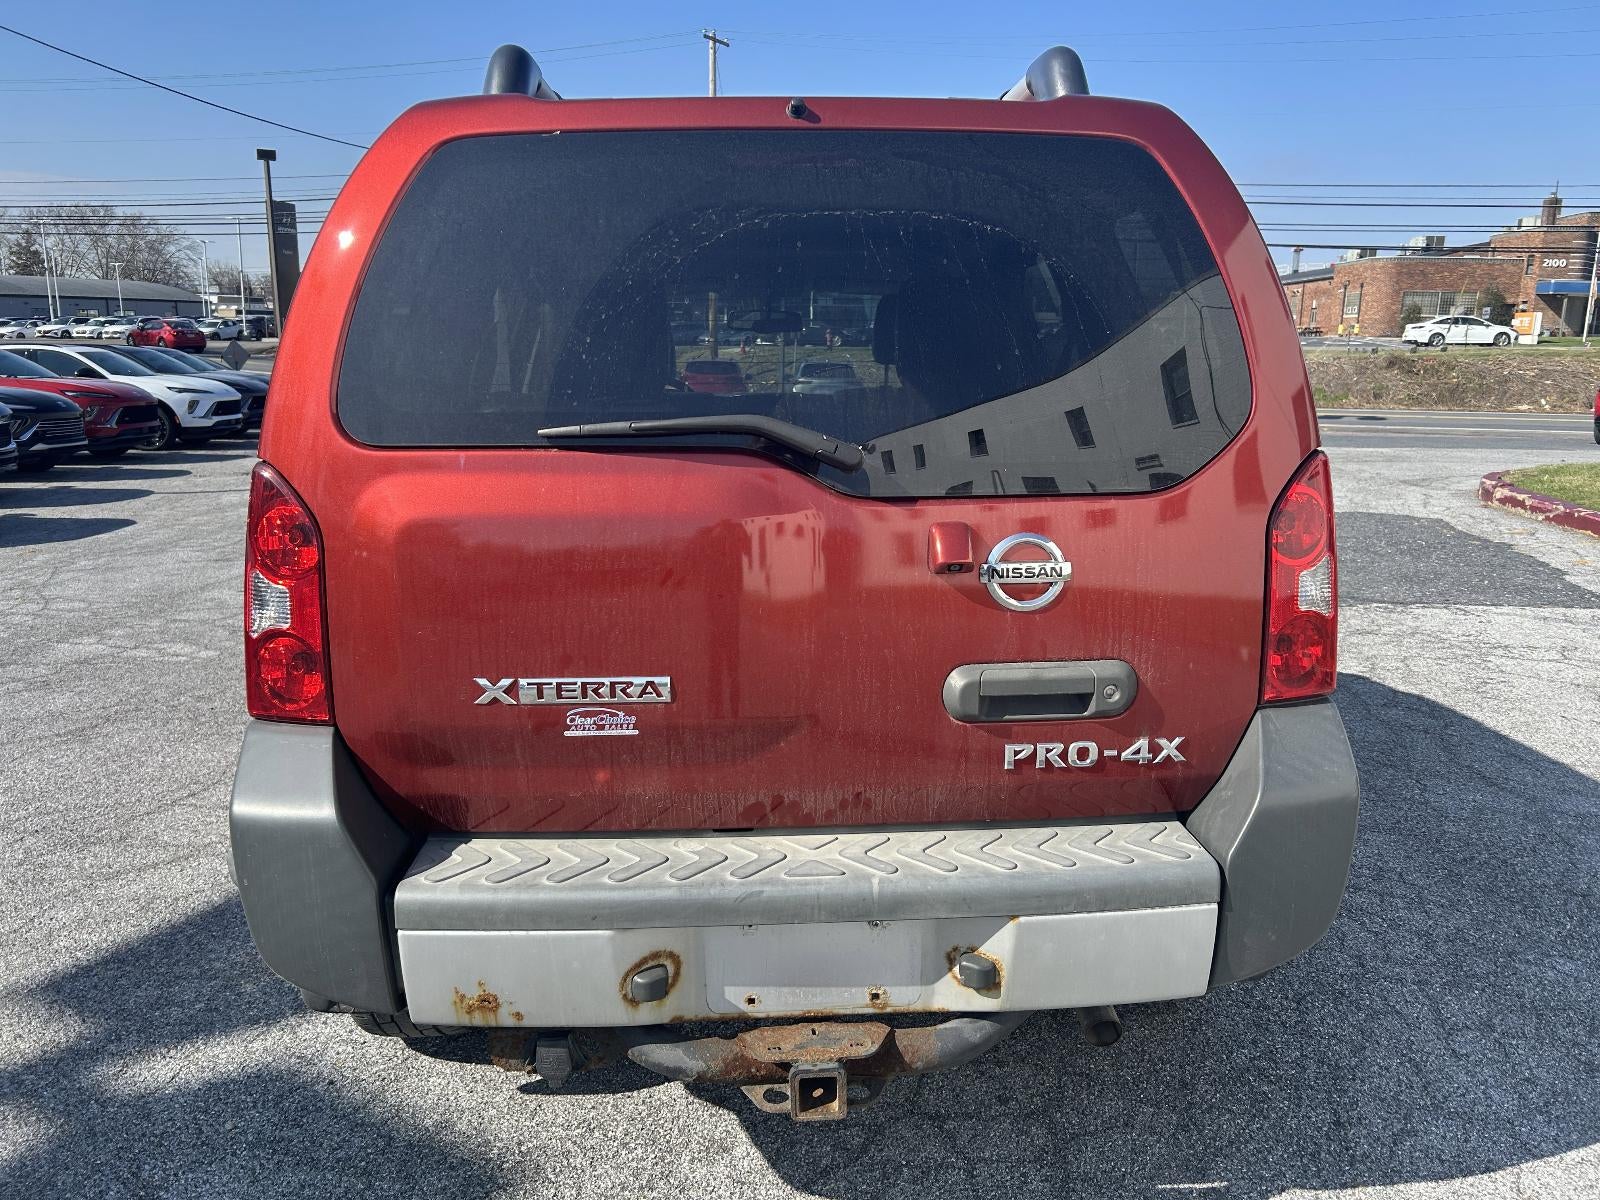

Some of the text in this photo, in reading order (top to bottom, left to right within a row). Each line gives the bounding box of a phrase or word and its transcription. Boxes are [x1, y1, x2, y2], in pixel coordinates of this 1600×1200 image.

[1542, 258, 1567, 268] 2100
[990, 566, 1063, 581] NISSAN
[1004, 736, 1186, 769] PRO-4X
